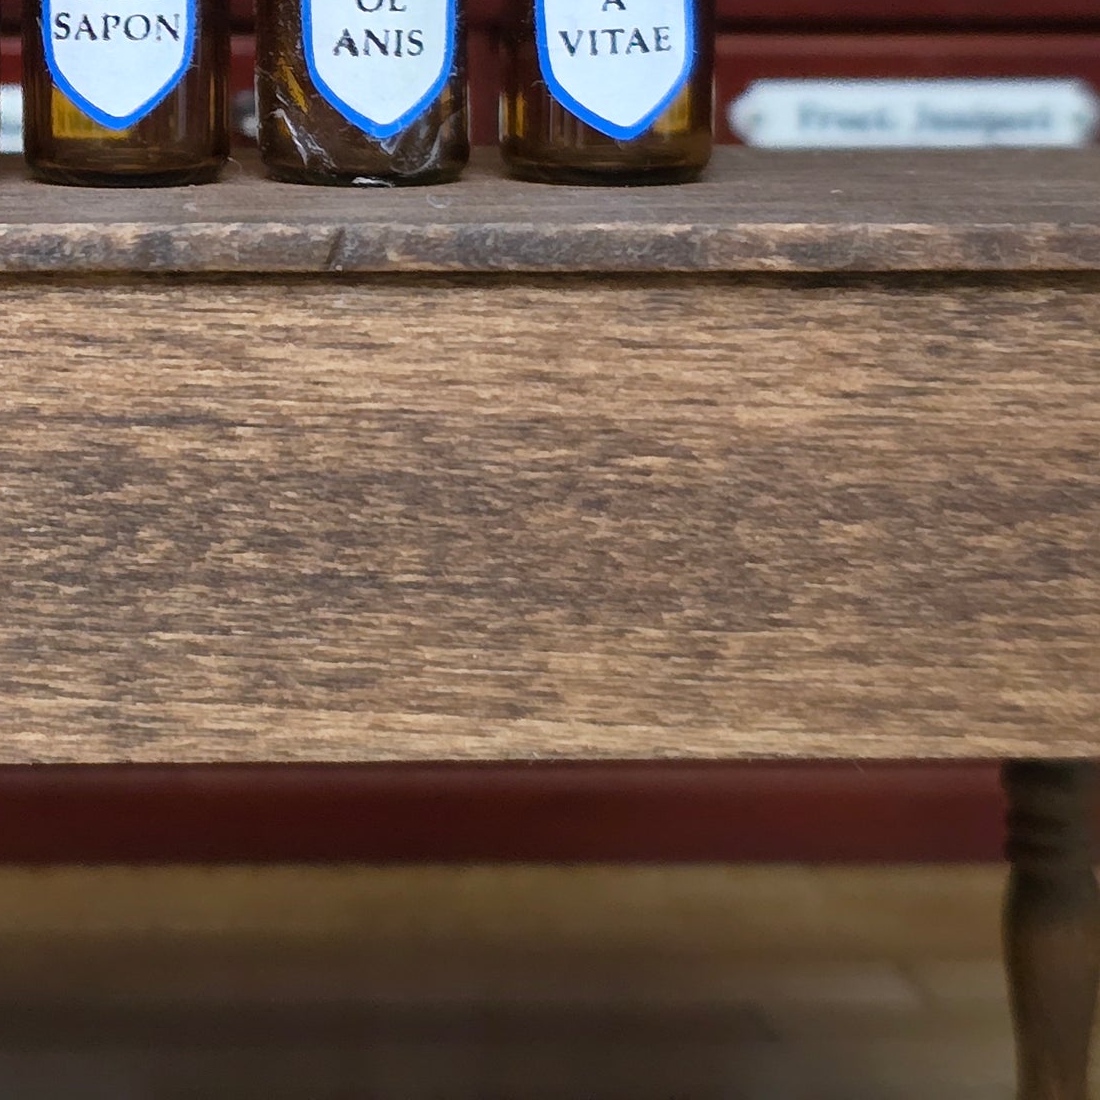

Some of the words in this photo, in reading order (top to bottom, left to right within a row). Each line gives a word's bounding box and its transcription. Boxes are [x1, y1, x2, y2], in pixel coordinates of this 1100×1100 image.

[53, 11, 181, 42] SAPON
[558, 26, 673, 57] VITAE
[333, 28, 424, 58] ANIS
